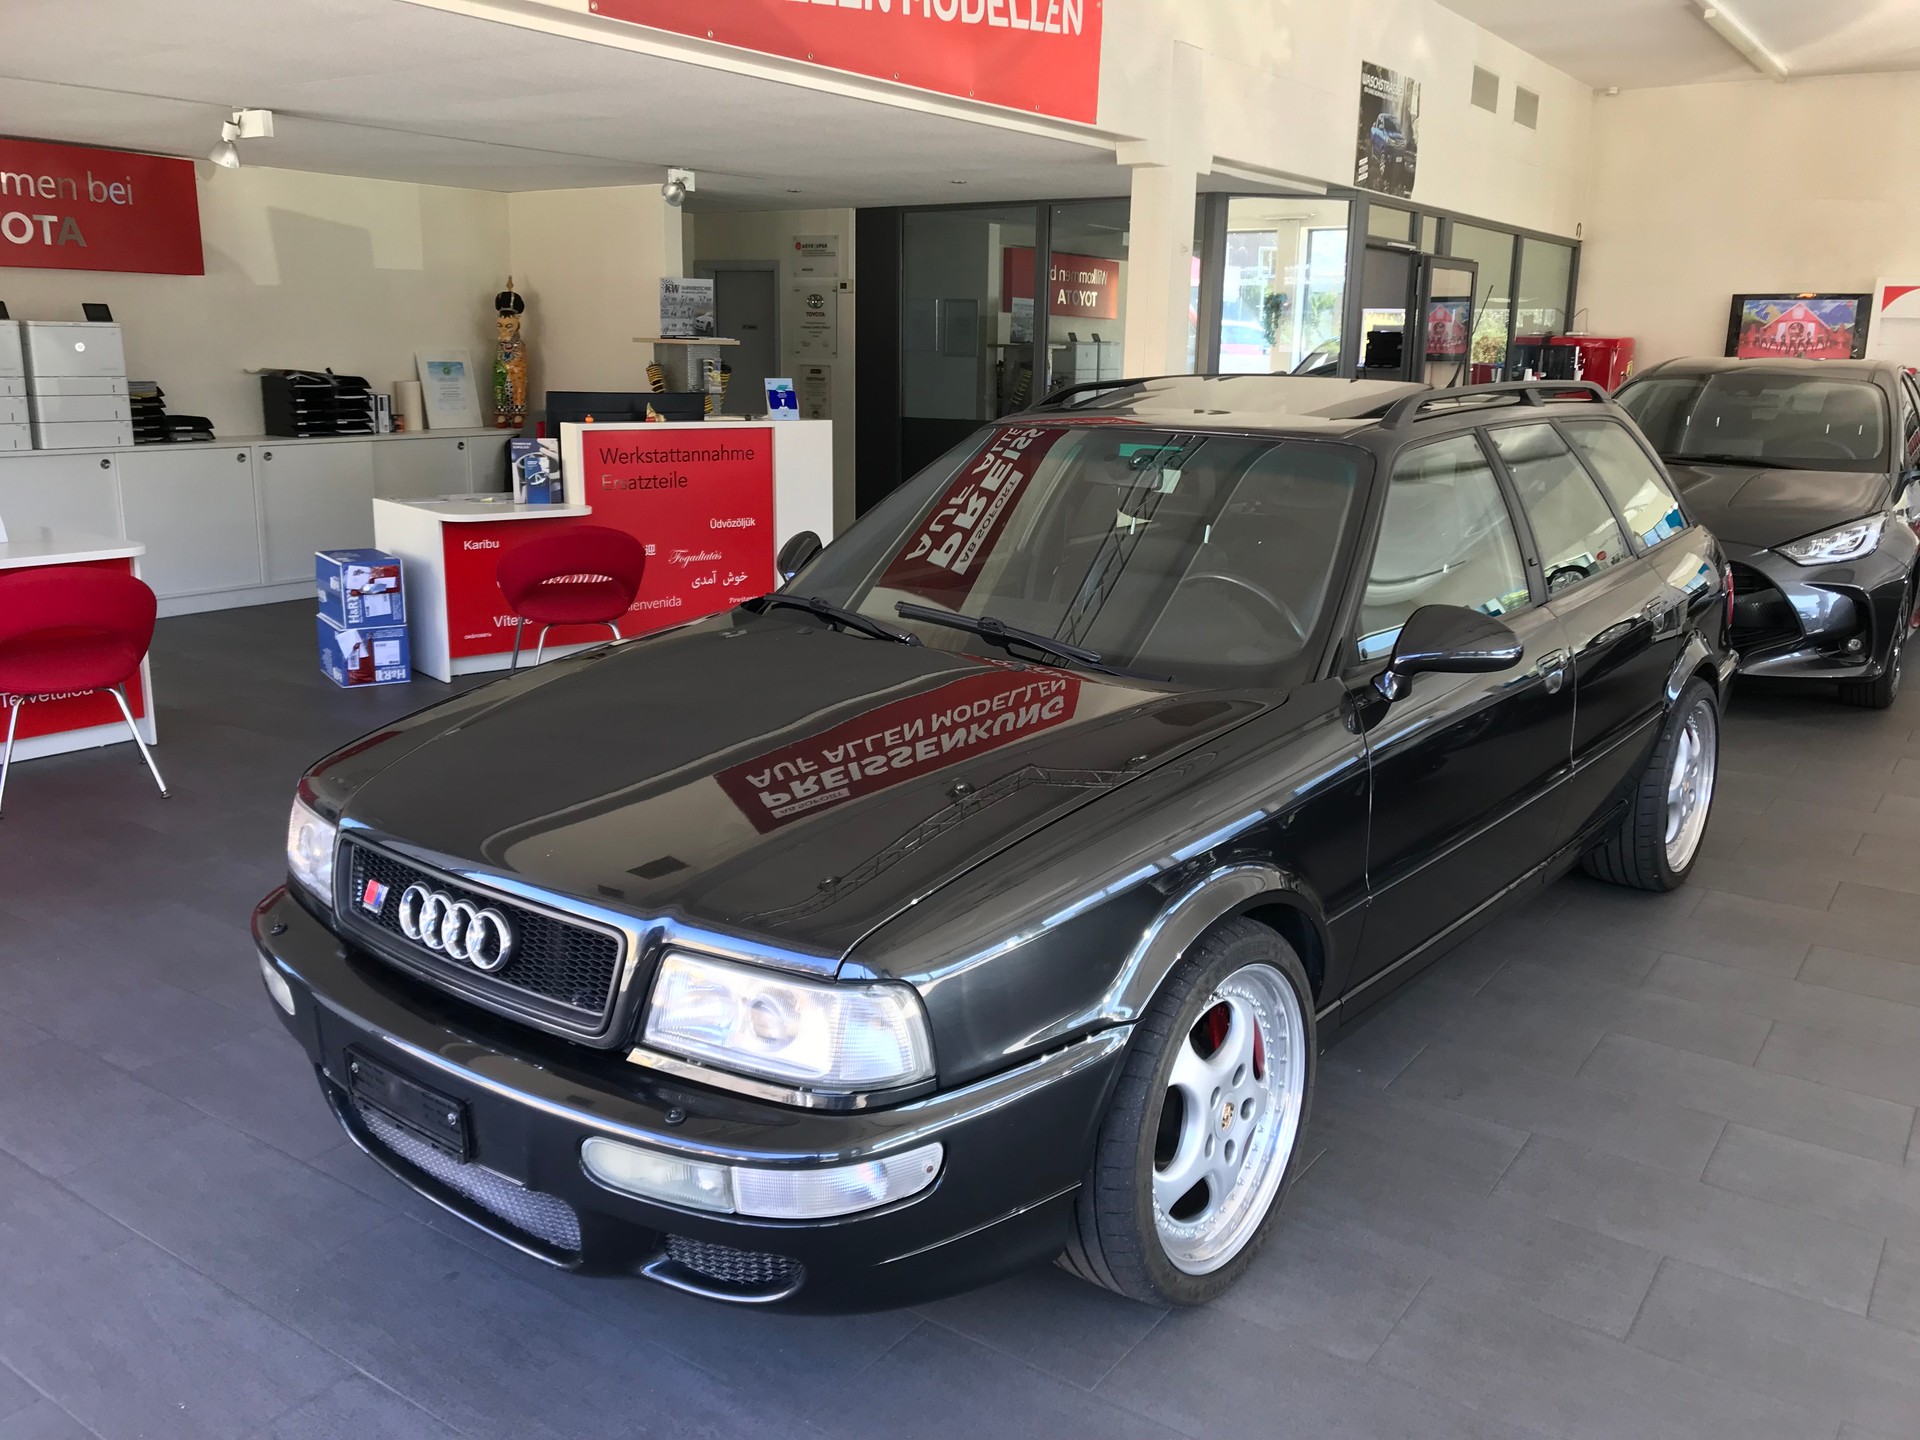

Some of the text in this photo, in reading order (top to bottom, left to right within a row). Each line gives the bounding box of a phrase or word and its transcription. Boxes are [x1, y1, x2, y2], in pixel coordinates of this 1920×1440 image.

[87, 171, 133, 205] bei
[599, 444, 755, 464] Werkstattannahme
[601, 471, 688, 491] Ersatzteile
[463, 540, 500, 550] Karibu
[643, 544, 656, 556] 迎
[722, 571, 748, 587] خوش
[628, 595, 682, 611] ienvenida
[383, 668, 406, 680] H&R
